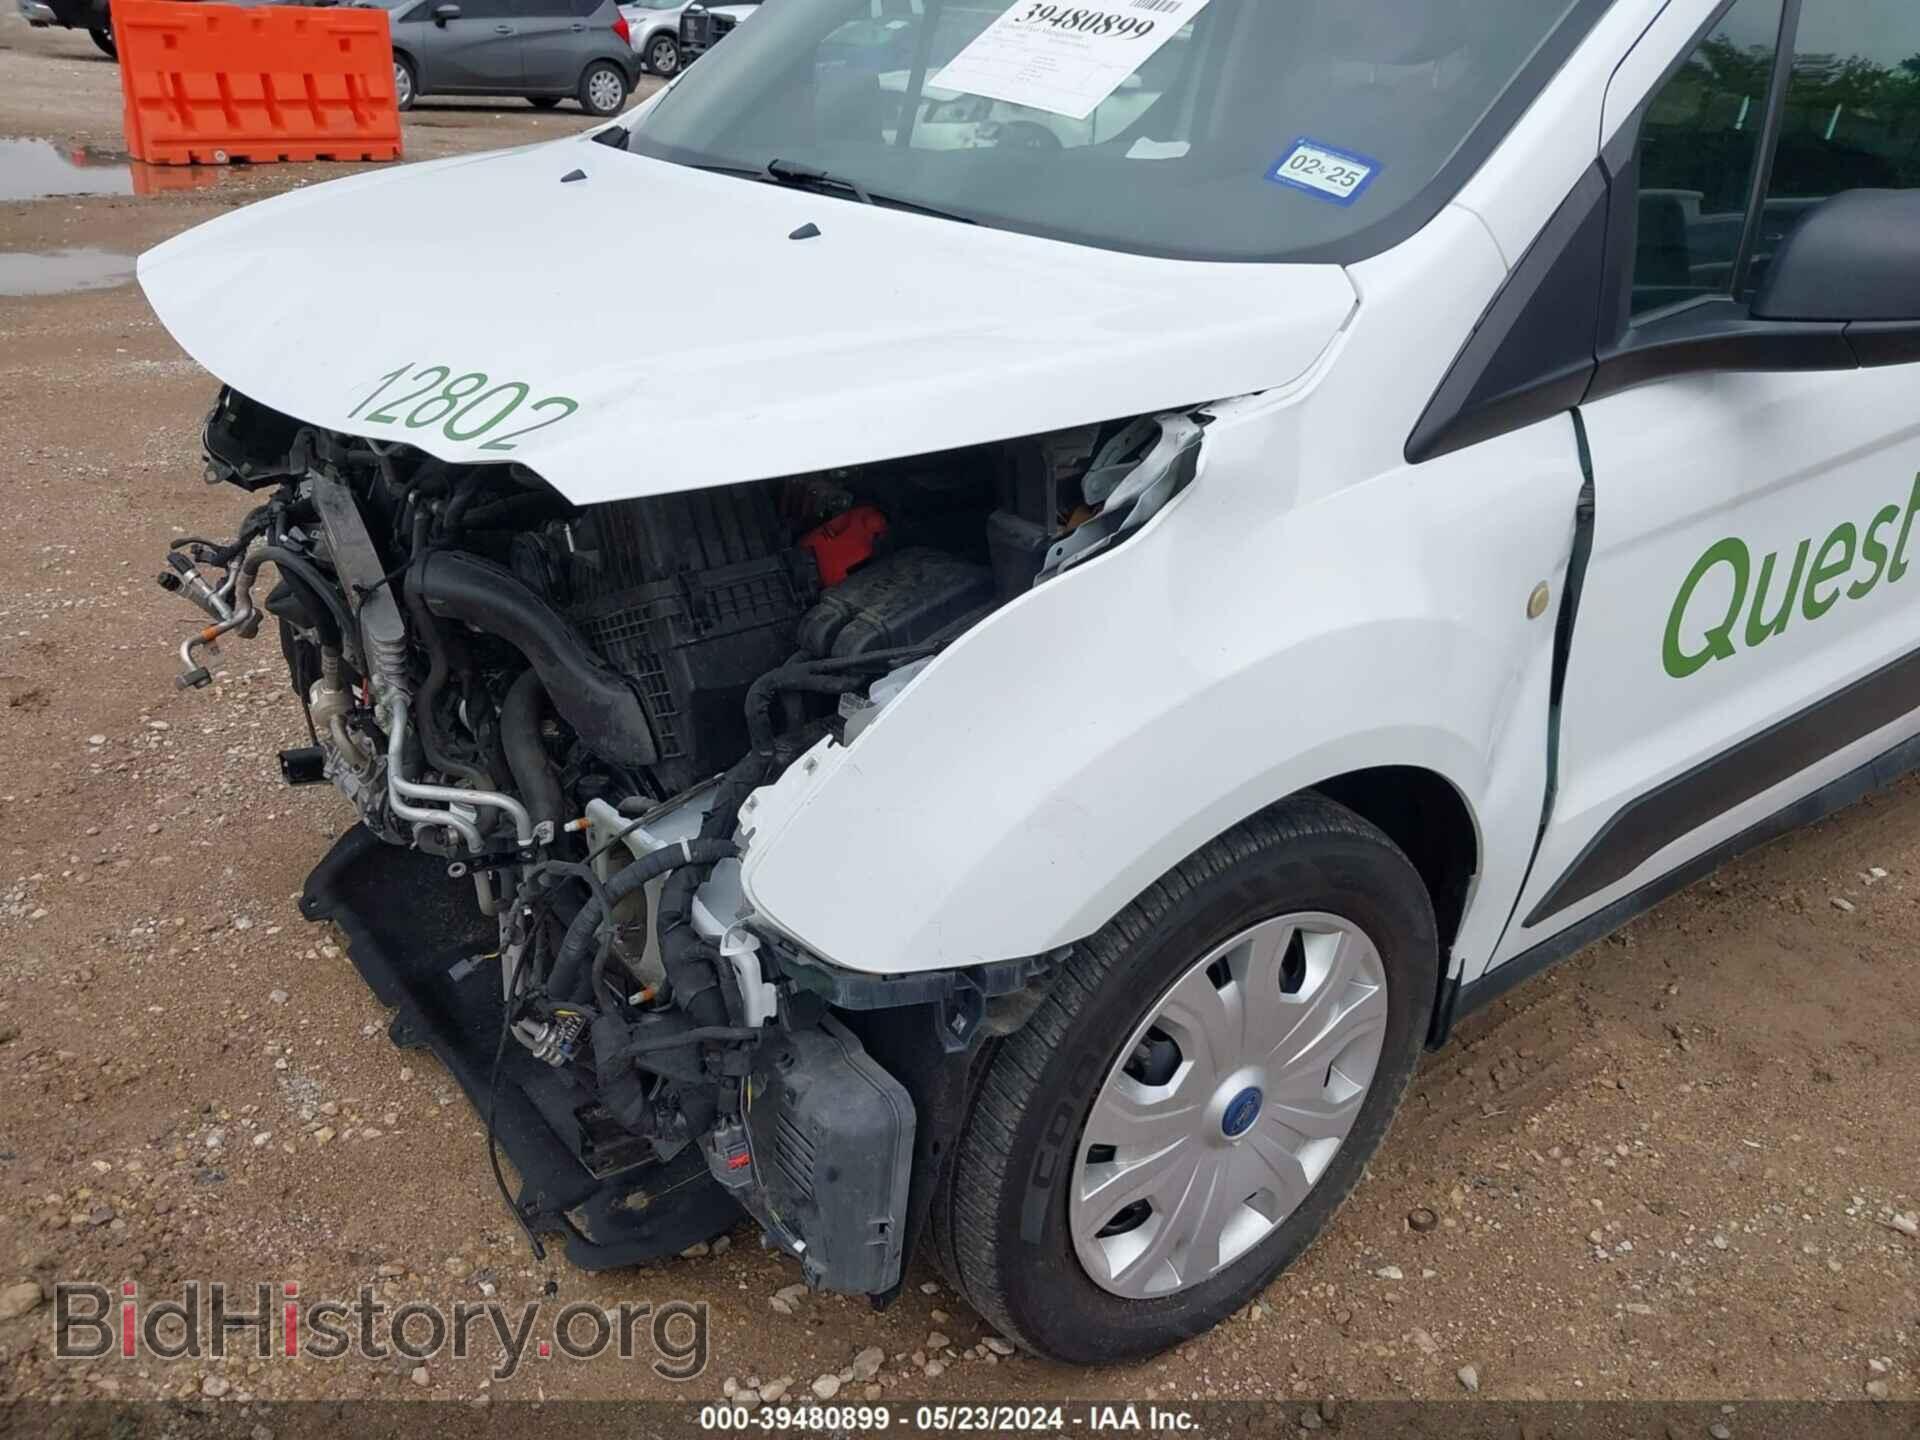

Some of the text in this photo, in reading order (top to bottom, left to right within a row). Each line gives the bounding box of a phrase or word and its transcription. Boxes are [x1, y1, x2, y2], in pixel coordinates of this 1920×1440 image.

[1014, 2, 1155, 41] 39480899
[1290, 154, 1361, 187] 02 25
[347, 361, 579, 451] 12802
[1661, 471, 1920, 679] Quest
